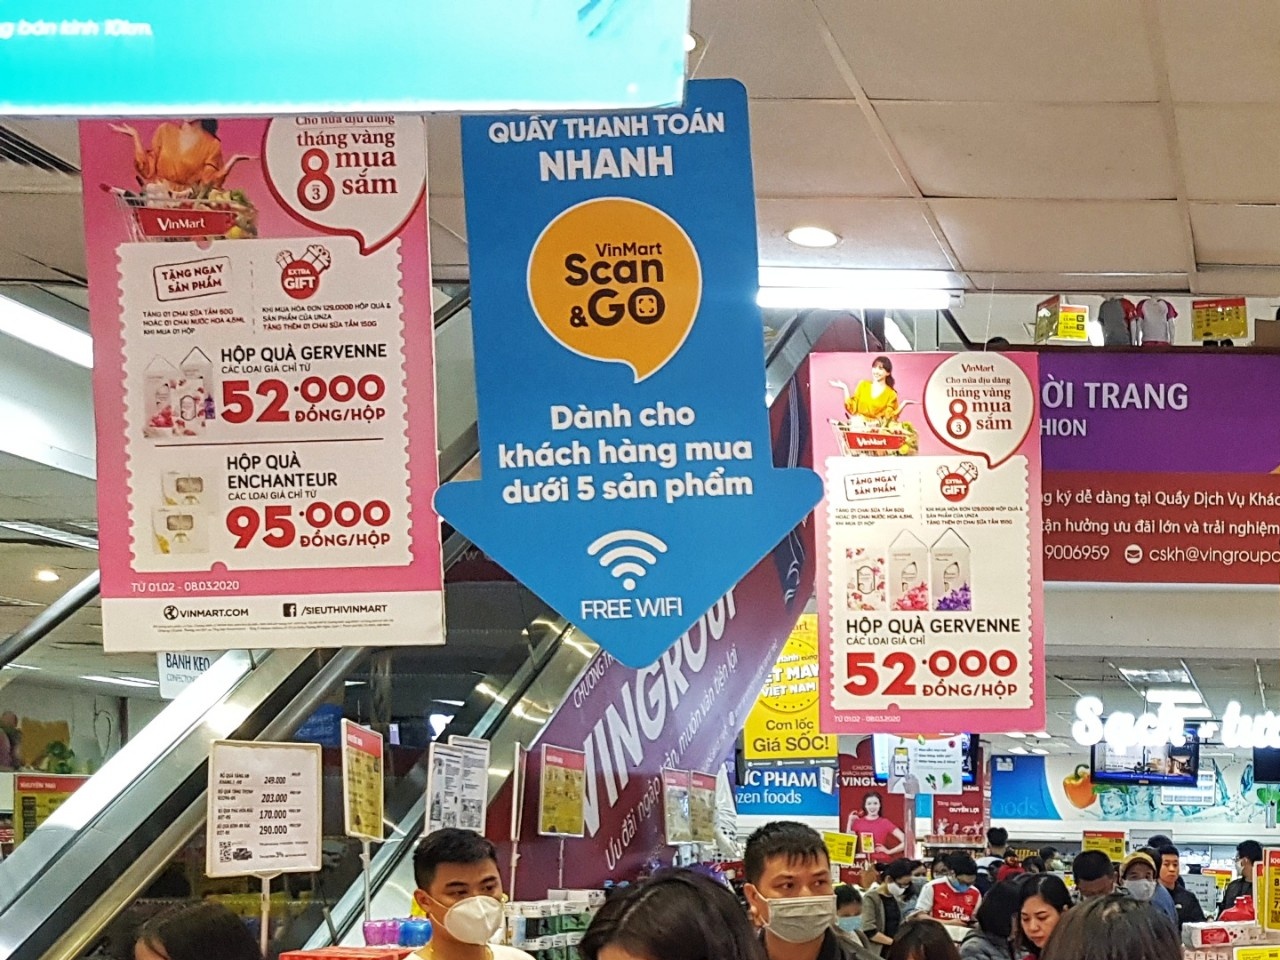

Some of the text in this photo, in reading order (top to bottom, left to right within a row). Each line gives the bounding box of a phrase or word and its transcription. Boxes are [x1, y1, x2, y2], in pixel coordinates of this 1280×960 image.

[563, 114, 648, 139] THANH
[654, 107, 725, 135] TOÁN
[297, 130, 396, 150] tháng vàng
[336, 150, 398, 168] mua
[538, 146, 674, 182] NHANH
[342, 168, 398, 196] sắm
[156, 217, 206, 232] VinMart
[596, 242, 662, 257] VinMart
[195, 264, 224, 278] NGAY
[564, 254, 664, 286] Scan
[167, 279, 191, 295] SẢN
[283, 276, 315, 290] GIFT
[221, 343, 388, 364] HỘP QUÀ GERVENNE
[961, 364, 995, 373] VinMart
[1084, 382, 1188, 410] TRANG
[550, 402, 696, 430] Dành cho
[226, 450, 301, 473] HỘP QUÀ
[498, 438, 752, 468] khách hàng mua
[228, 472, 338, 490] ENCHANTEUR
[502, 466, 753, 505] dưới 5 sản phẩm
[1056, 491, 1072, 506] ký
[1076, 488, 1092, 504] dễ
[1096, 490, 1131, 508] dàng
[1134, 491, 1152, 506] tại
[1155, 490, 1191, 509] Quầy
[1194, 491, 1224, 508] Dịch
[1227, 492, 1246, 510] Vụ
[1065, 518, 1109, 536] hưởng
[1113, 520, 1130, 533] ưu
[1134, 518, 1155, 534] đãi
[1158, 518, 1180, 534] lớn
[1184, 520, 1200, 534] và
[1202, 519, 1224, 534] trải
[1229, 521, 1280, 537] nghiệm
[1044, 545, 1110, 560] 9006959
[132, 580, 146, 594] TỪ
[180, 604, 388, 618] VINMART.COM /SIEUTHIVINMART
[580, 598, 682, 620] FREE WIFI
[846, 616, 1021, 639] HỘP QUÀ GERVENNE
[790, 682, 816, 694] NAM
[766, 718, 814, 732] Cơn lốc
[753, 731, 830, 752] Giá SỐC!
[764, 788, 802, 804] foods
